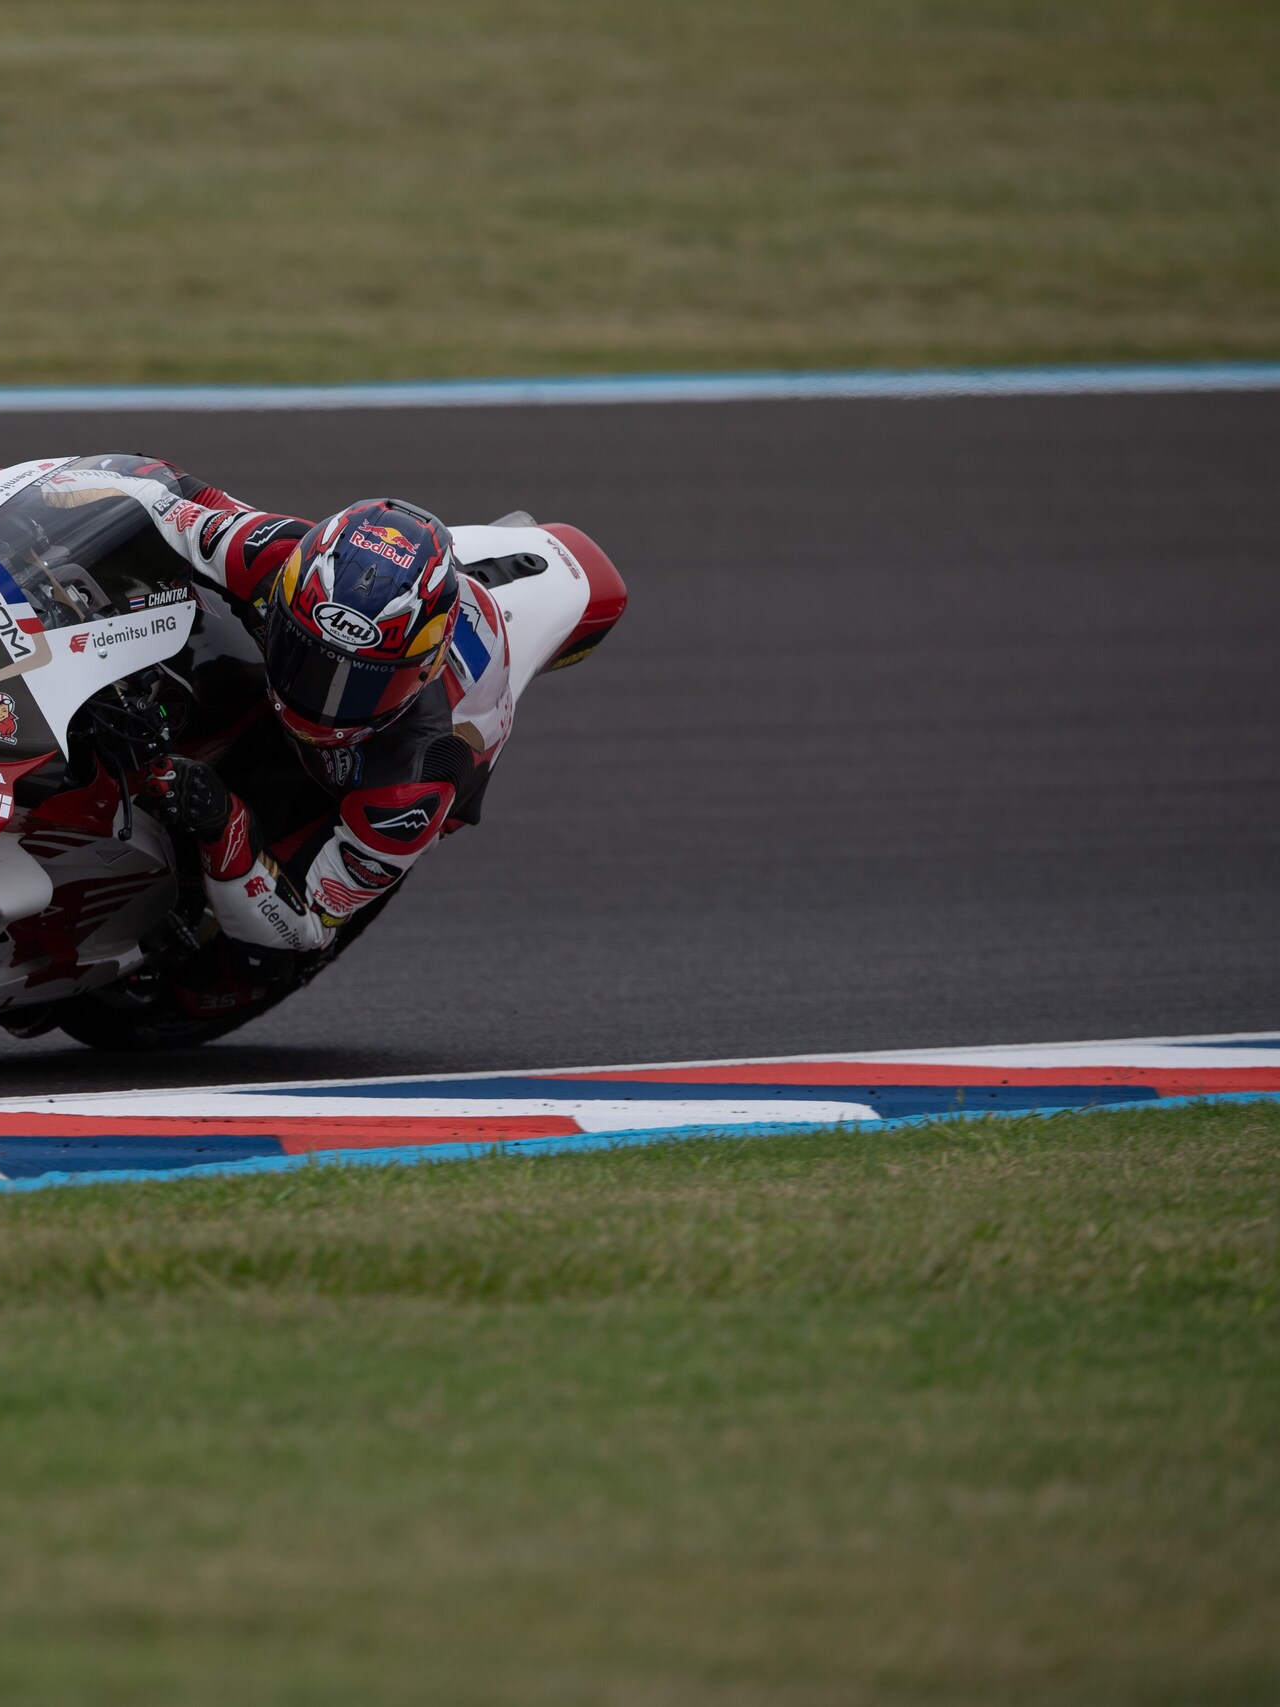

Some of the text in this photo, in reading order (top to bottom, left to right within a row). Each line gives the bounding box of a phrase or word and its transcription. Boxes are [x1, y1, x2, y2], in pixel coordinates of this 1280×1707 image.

[349, 531, 415, 569] Red Bull
[546, 538, 580, 580] SENA
[148, 587, 188, 607] CHANTRA
[91, 616, 177, 648] idemitsu IRG
[319, 610, 374, 641] Arai
[286, 620, 397, 674] GIVES YOU WINGS
